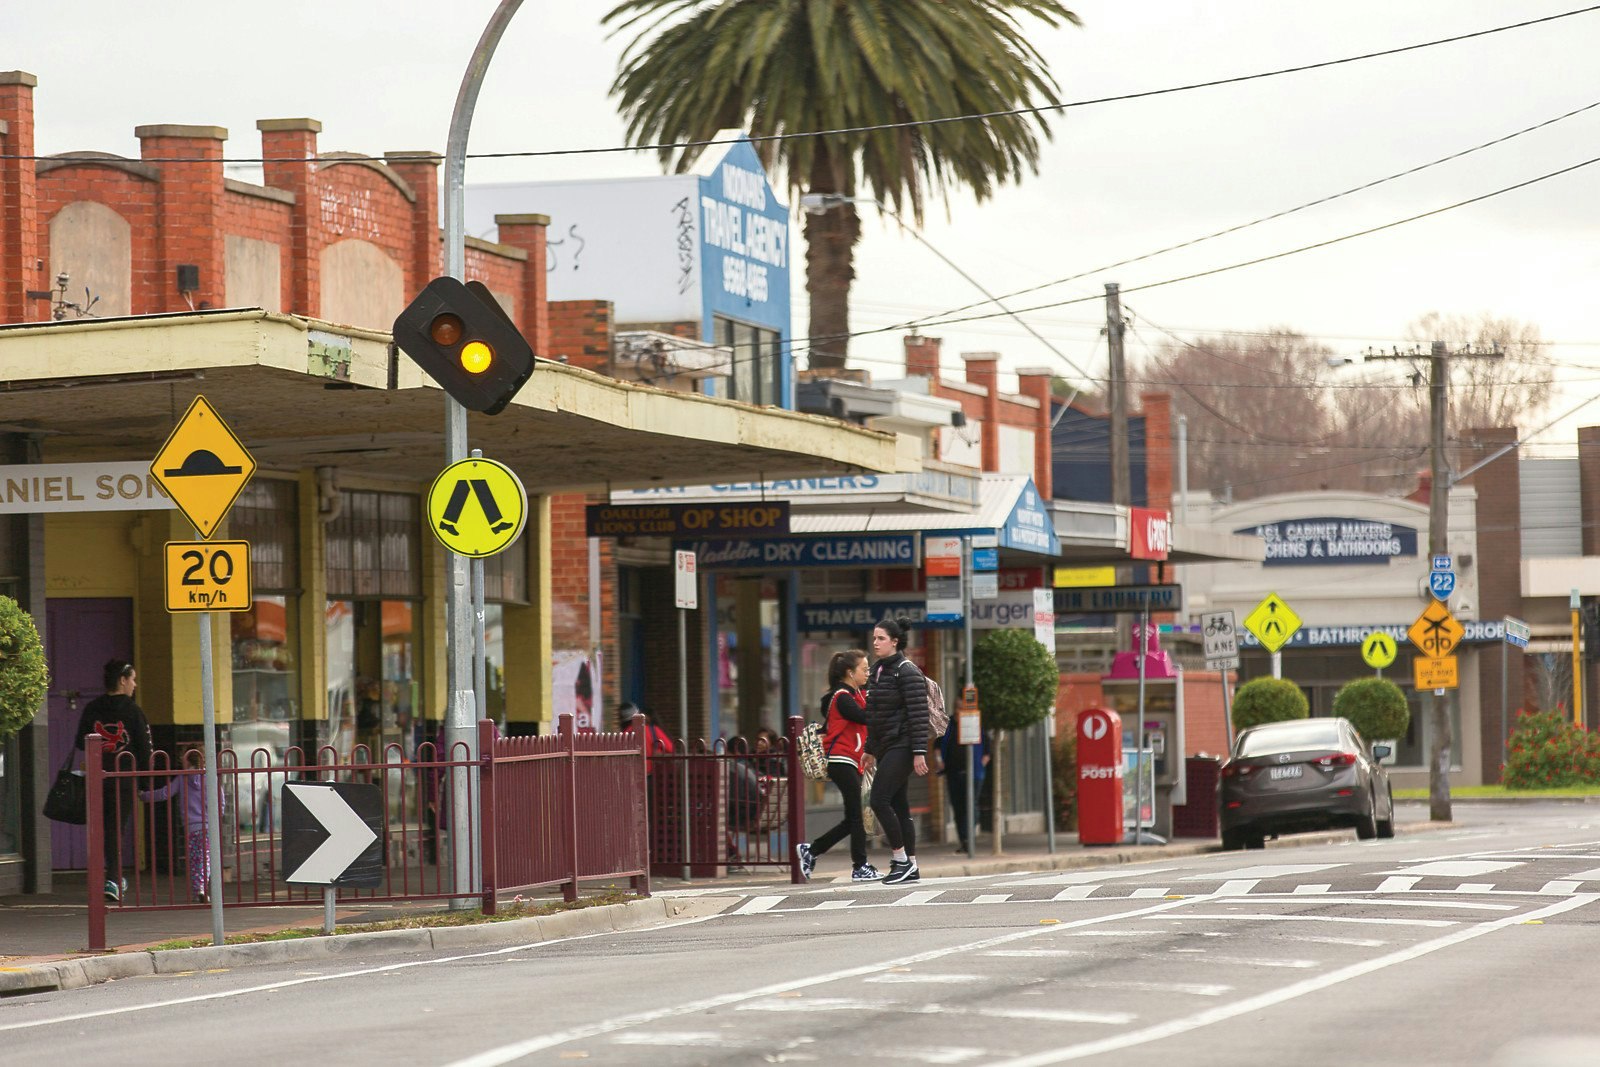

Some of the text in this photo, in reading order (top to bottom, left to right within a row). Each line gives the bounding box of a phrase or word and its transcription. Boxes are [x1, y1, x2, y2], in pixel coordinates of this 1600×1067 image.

[701, 196, 745, 256] TRAVEL
[745, 212, 787, 269] AGENCY
[0, 477, 84, 503] NIEL
[640, 520, 676, 532] CLUB
[682, 507, 781, 529] OP SHOP
[764, 543, 804, 561] DRY
[812, 539, 911, 559] CLEANING
[1311, 541, 1325, 558] &
[1327, 537, 1401, 558] BATHROOMS
[181, 549, 233, 585] 20
[1433, 574, 1453, 591] 22
[188, 590, 227, 606] km/h
[805, 608, 876, 626] TRAVEL
[1206, 640, 1235, 655] LANE
[1081, 767, 1114, 780] POST
